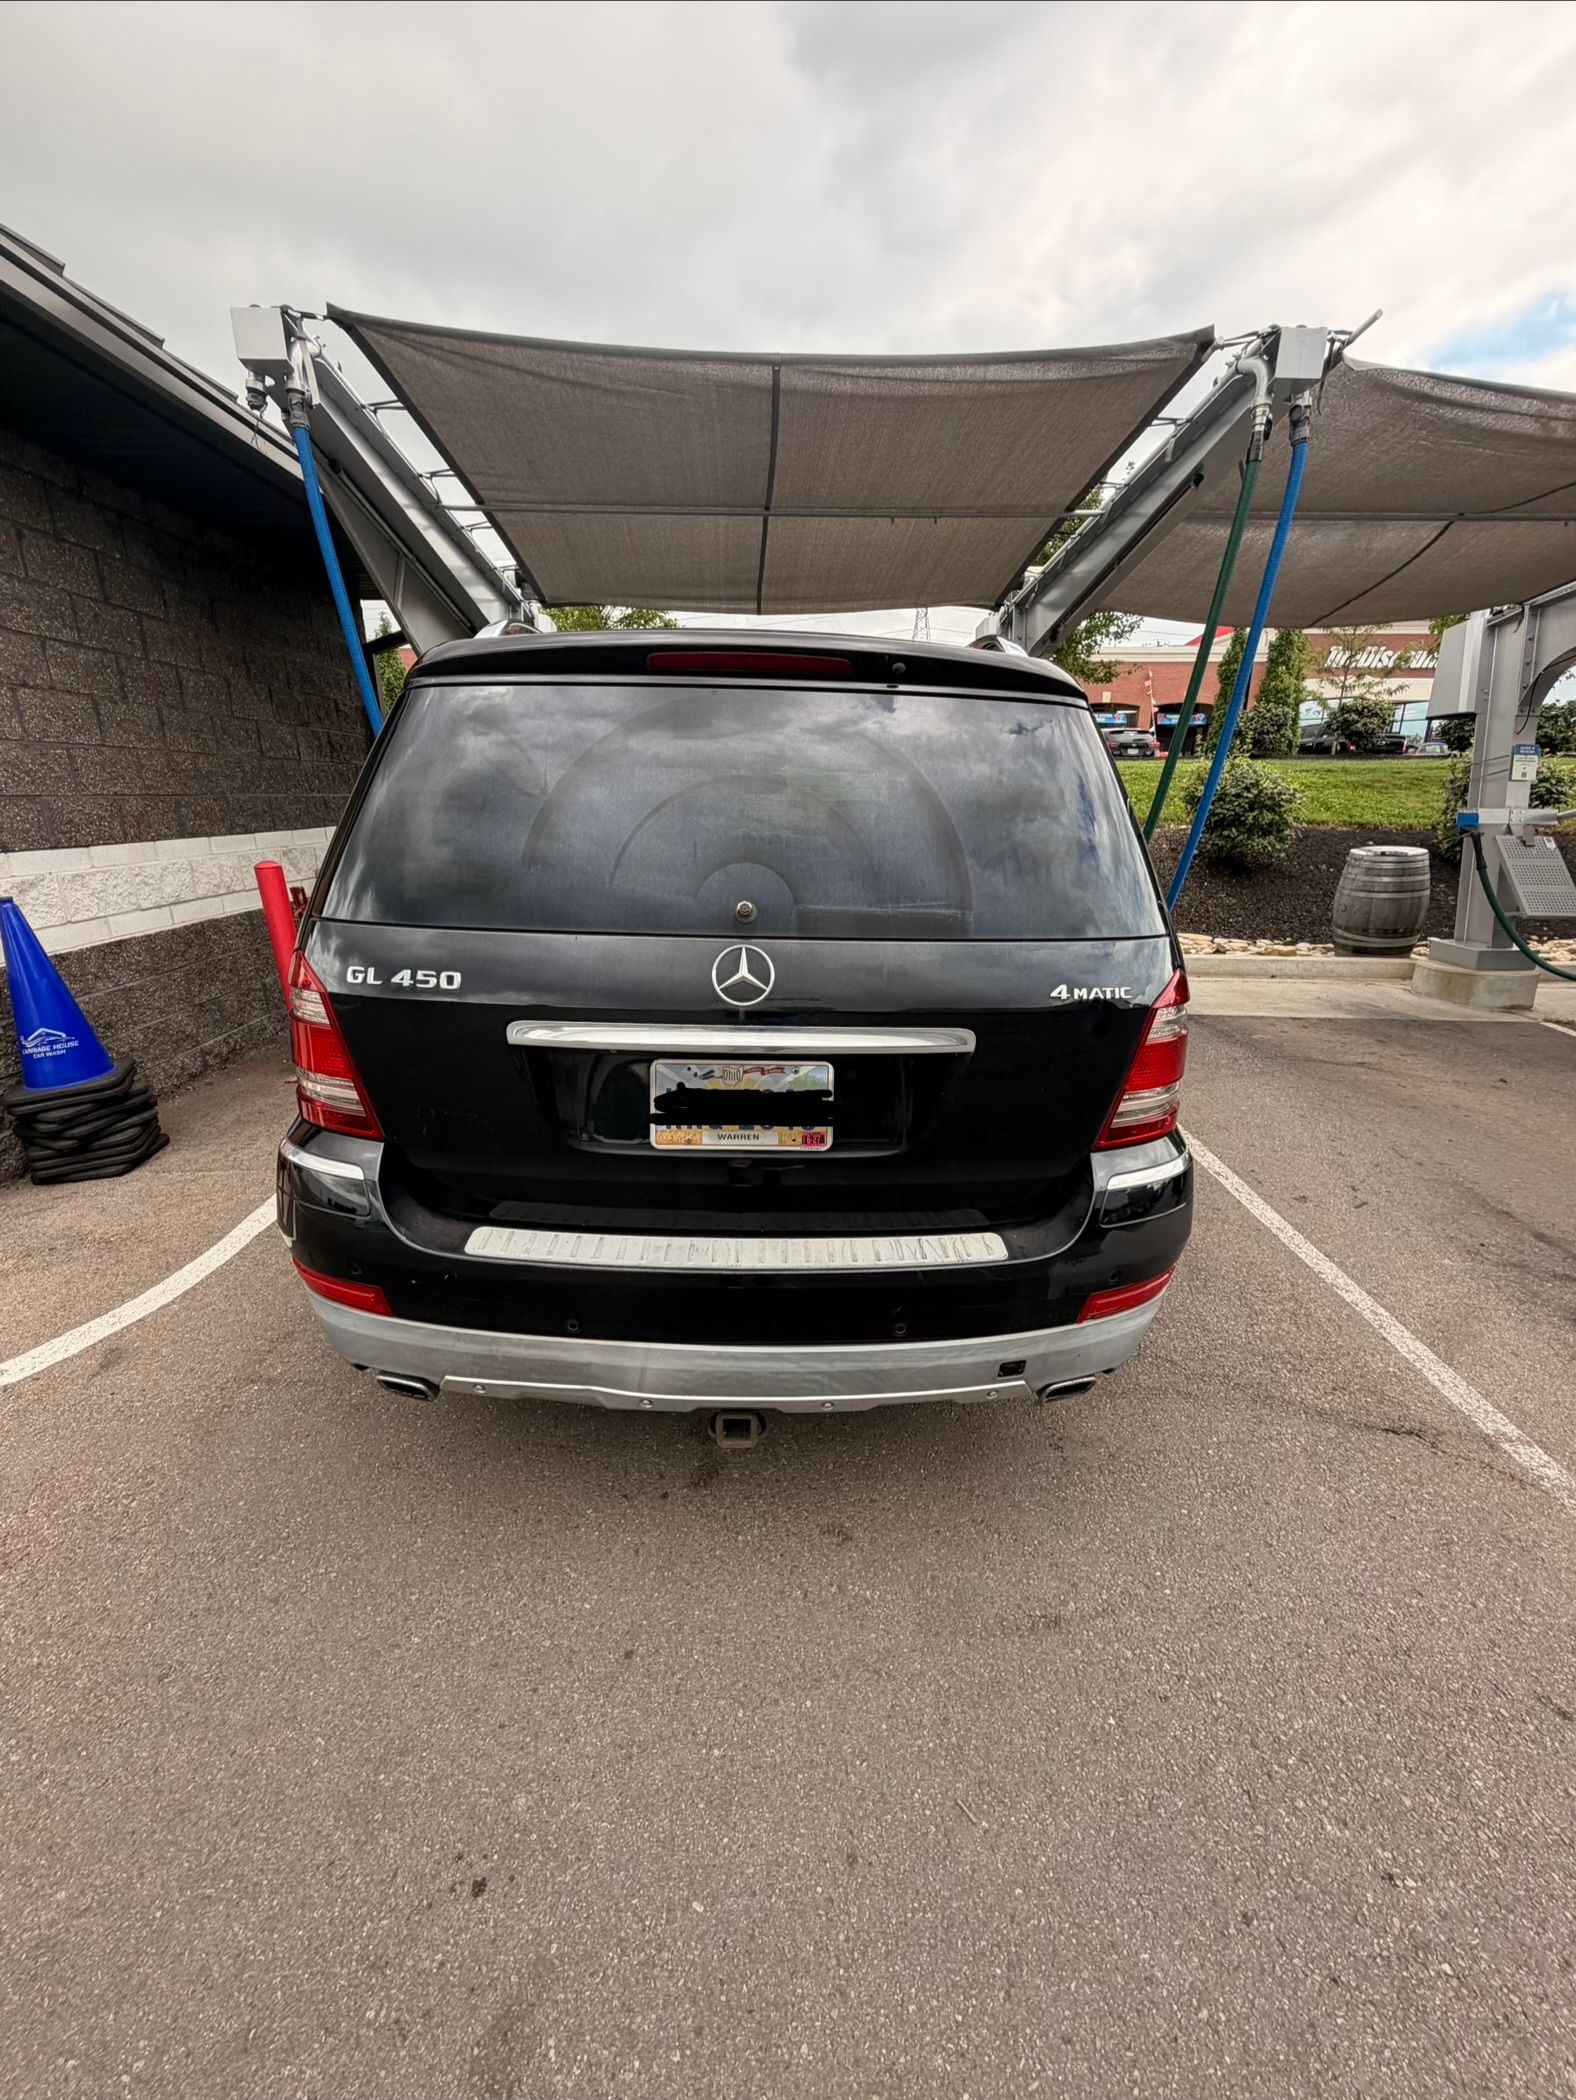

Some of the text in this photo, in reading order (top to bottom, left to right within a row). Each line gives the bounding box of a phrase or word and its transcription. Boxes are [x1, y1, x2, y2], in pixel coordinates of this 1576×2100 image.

[346, 966, 462, 990] GL 450
[53, 1041, 79, 1050] HOUSE
[46, 1049, 66, 1057] WASH
[717, 1133, 760, 1141] WARREN
